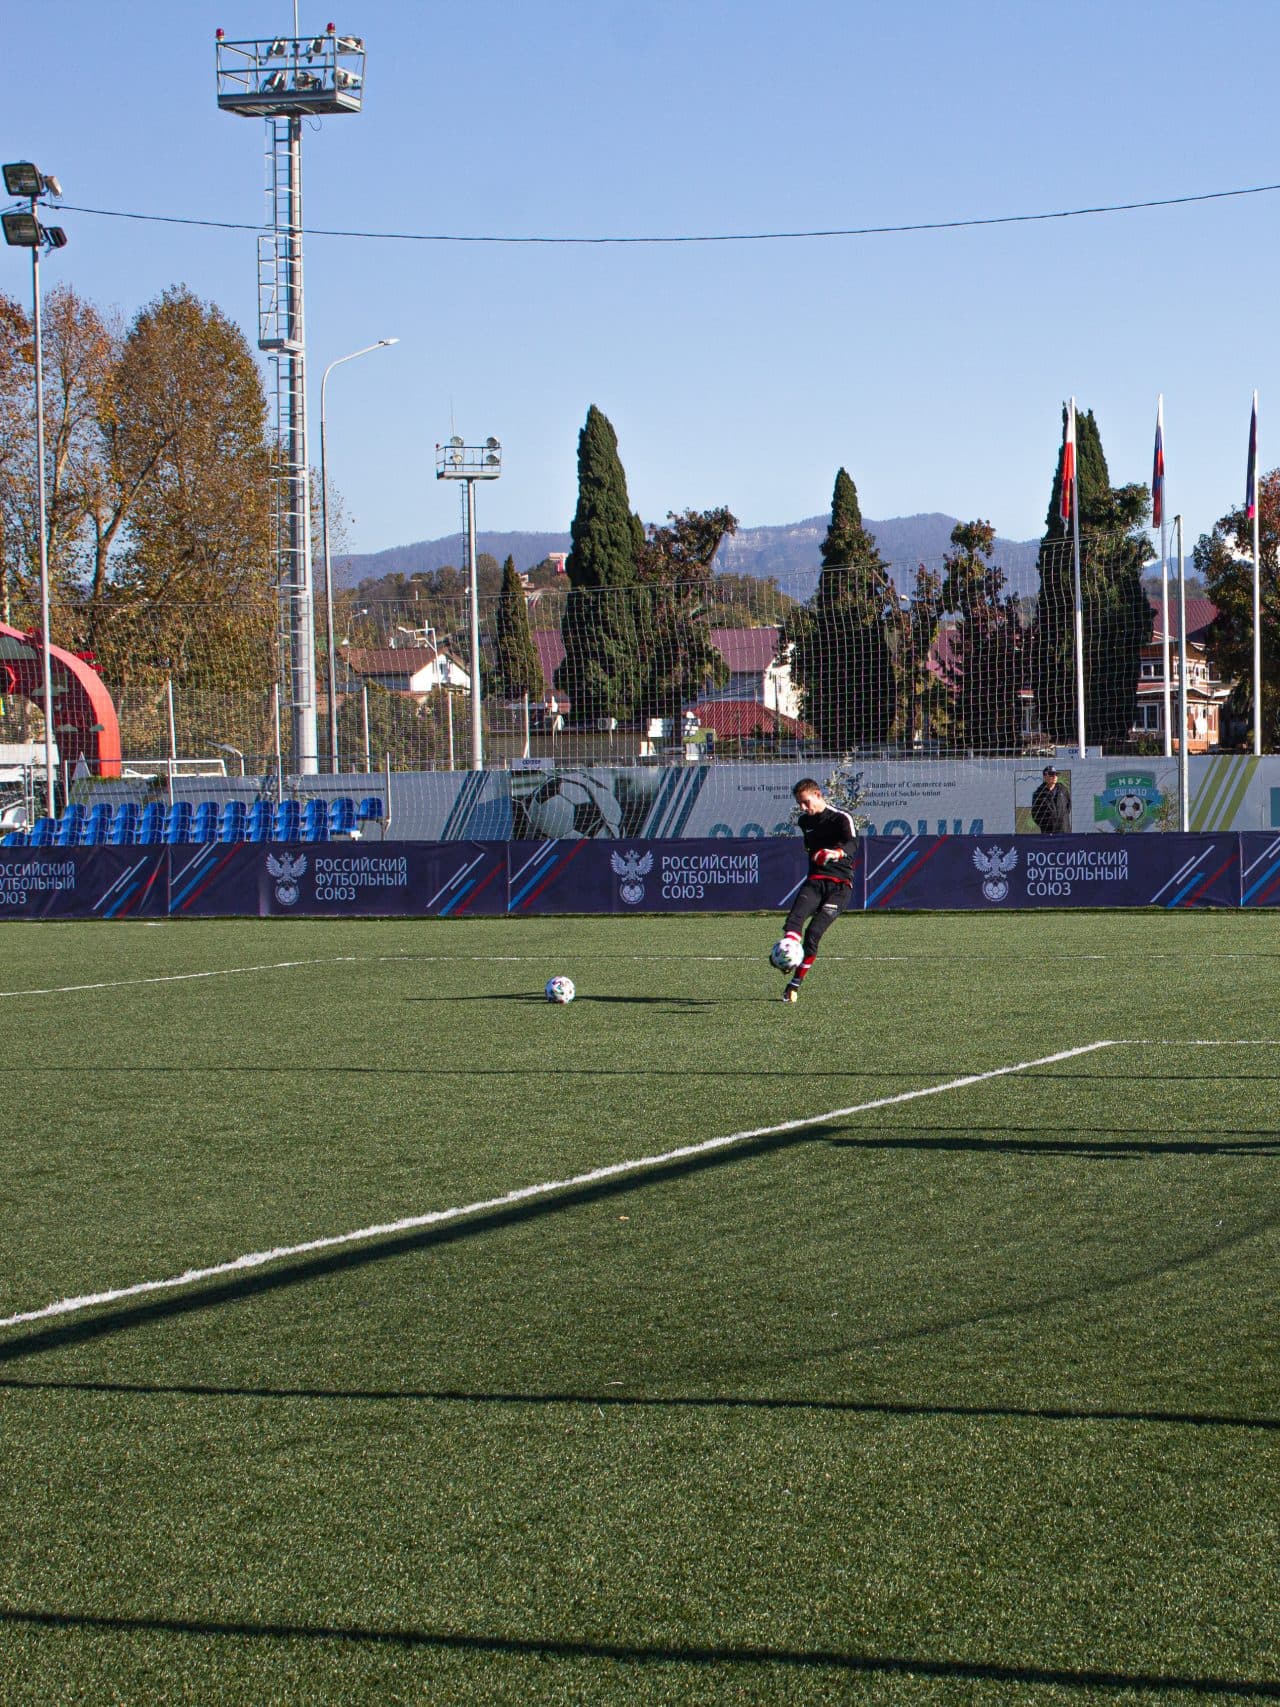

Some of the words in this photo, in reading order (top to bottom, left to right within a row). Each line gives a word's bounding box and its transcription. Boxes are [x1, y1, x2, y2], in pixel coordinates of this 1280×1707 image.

[315, 857, 408, 872] РОССИЙСКИЙ
[662, 854, 760, 870] РОССИЙСКИЙ
[1026, 850, 1129, 866] РОССИЙСКИЙ
[0, 861, 76, 877] ОССИЙСКИЙ
[1026, 865, 1129, 881] ФУТБОЛЬНЫЙ
[0, 876, 76, 890] УТБОЛЬНЫЙ
[315, 872, 408, 887] ФУТБОЛЬНЫЙ
[662, 869, 760, 885] ФУТБОЛЬНЫЙ
[315, 887, 356, 901] СОЮЗ
[662, 885, 705, 899] СОЮЗ
[1026, 882, 1072, 896] СОЮЗ
[0, 891, 27, 905] ОЮЗ
